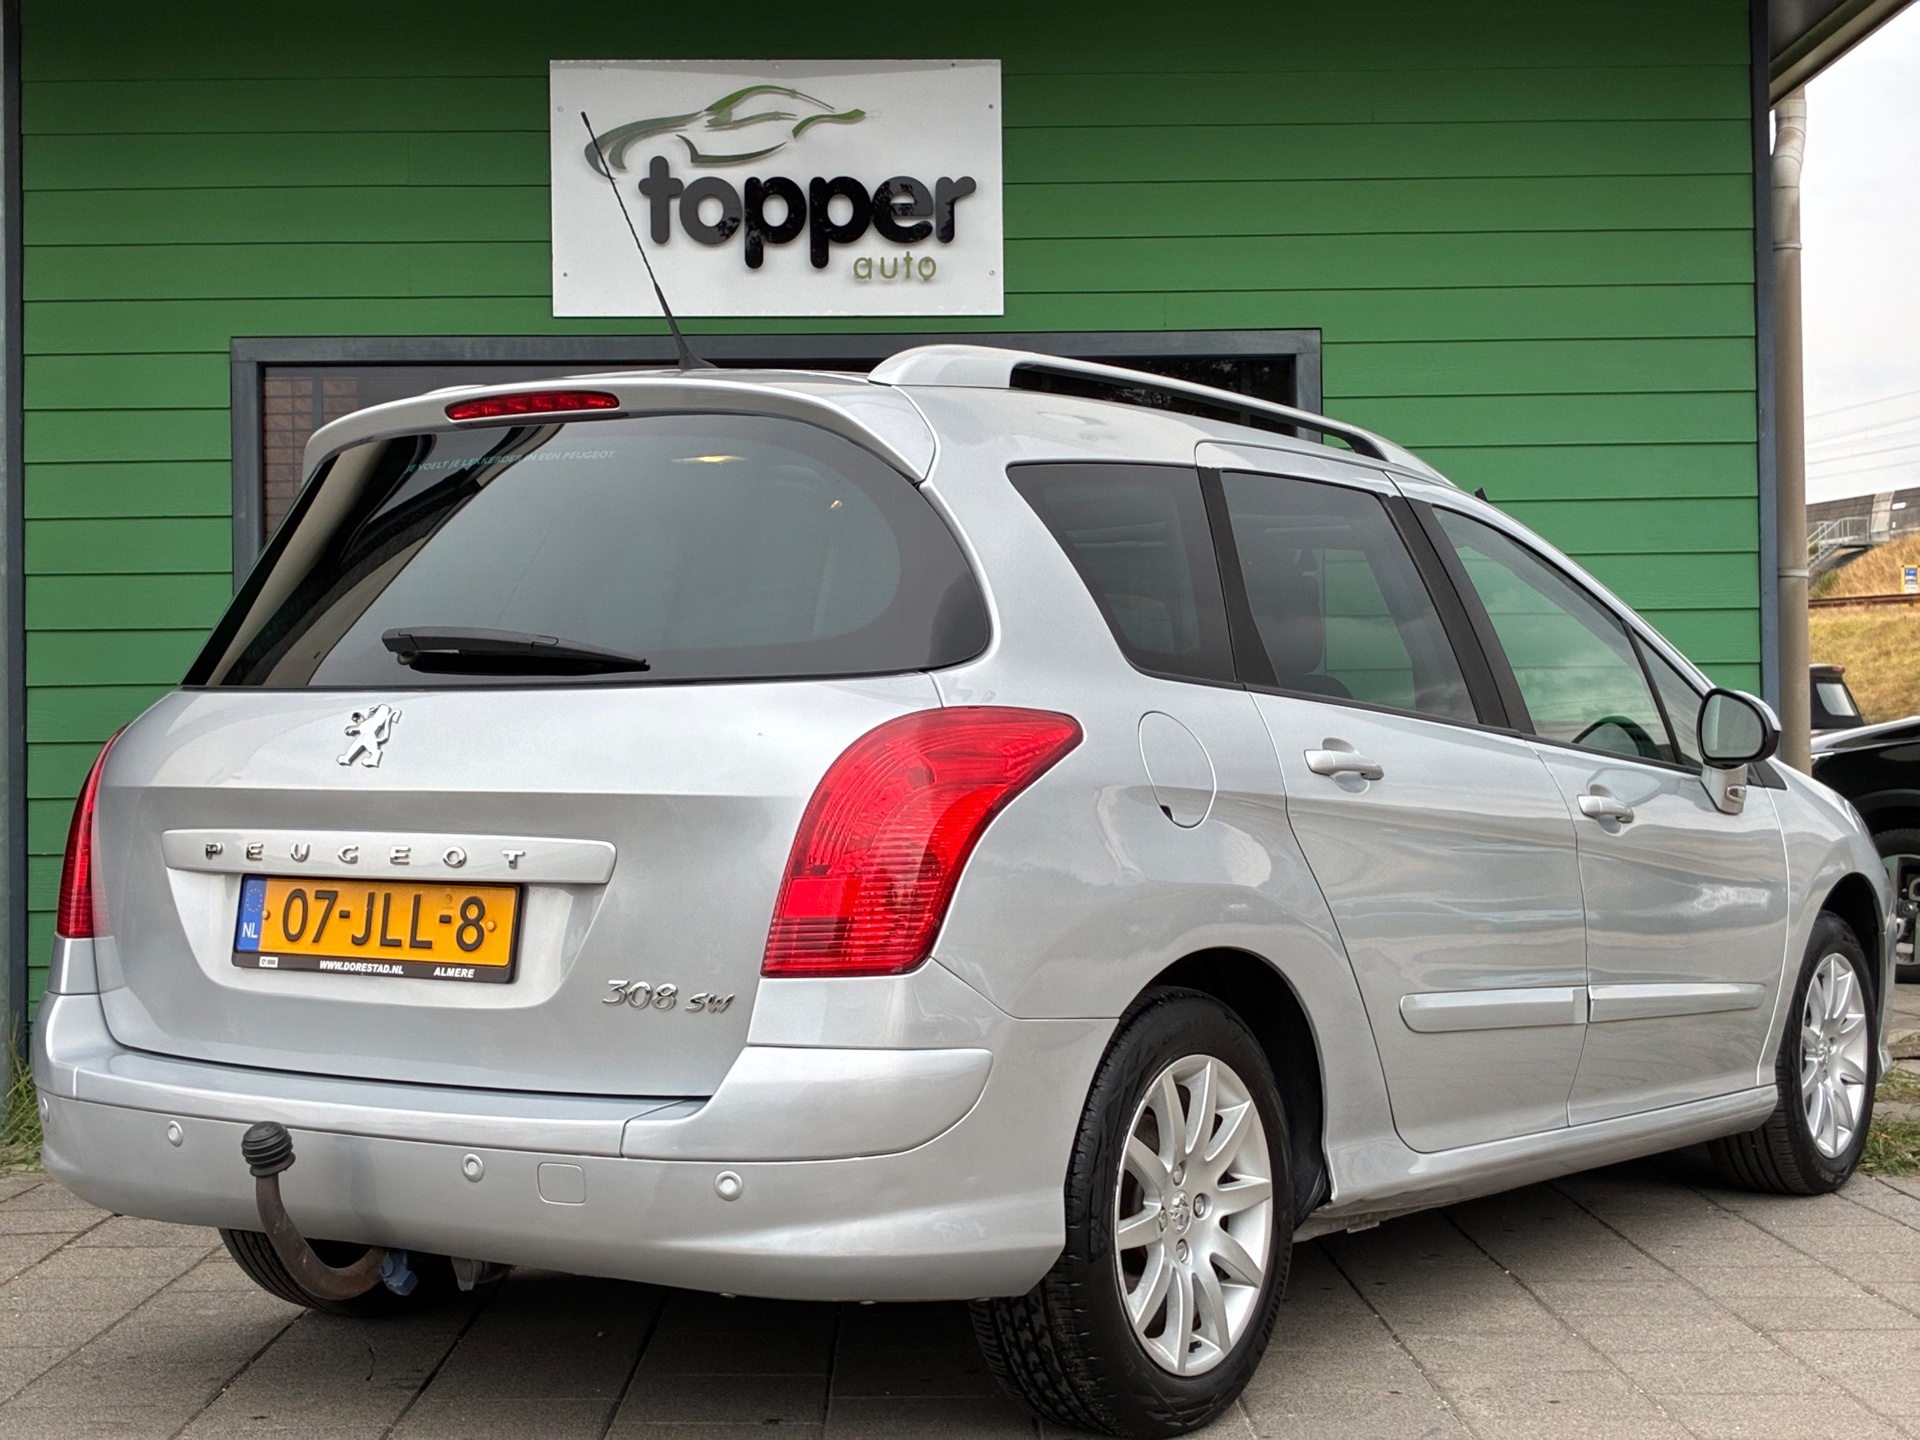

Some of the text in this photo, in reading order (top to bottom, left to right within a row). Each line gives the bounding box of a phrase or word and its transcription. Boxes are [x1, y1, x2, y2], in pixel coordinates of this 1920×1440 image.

[638, 155, 977, 270] topper
[853, 251, 937, 281] auto
[538, 451, 561, 461] EEN
[205, 842, 526, 869] PEUGEOT
[242, 922, 258, 938] NL
[282, 888, 486, 952] 07-JLL-8
[320, 960, 475, 979] WWW.DORESTAD.NL ALMERE
[602, 979, 678, 1011] 308
